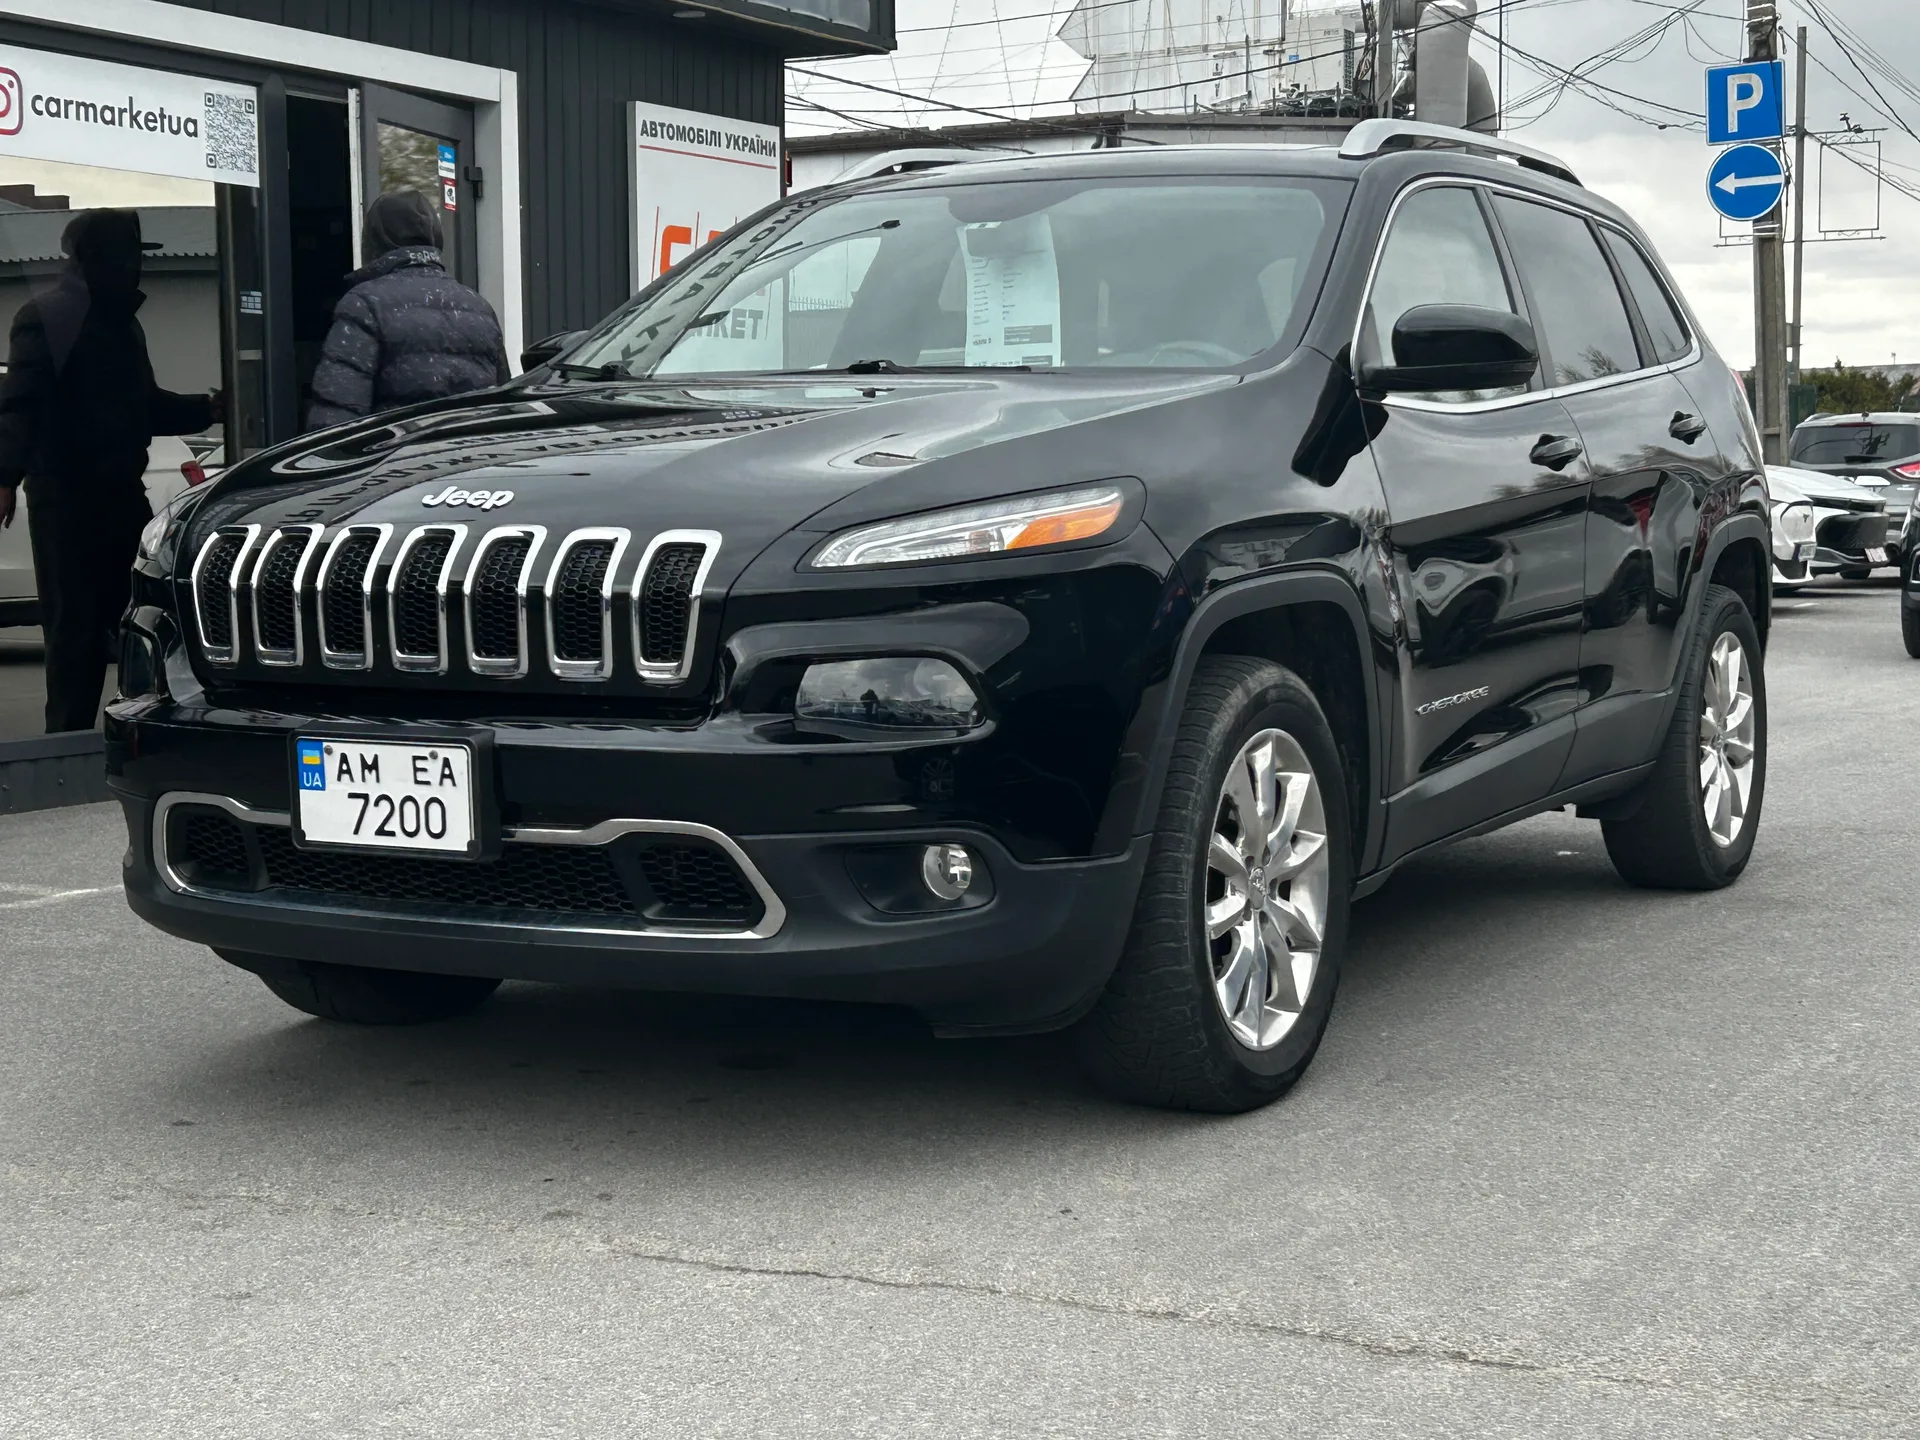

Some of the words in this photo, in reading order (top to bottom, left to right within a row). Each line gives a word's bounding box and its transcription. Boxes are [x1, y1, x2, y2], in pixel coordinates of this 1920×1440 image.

[31, 95, 199, 138] carmarketua
[1727, 73, 1764, 133] P
[640, 119, 722, 148] АВТОМОБІЛІ
[724, 133, 777, 158] УКРАЇНИ
[421, 486, 515, 512] Jeep
[1415, 685, 1490, 716] CHEROKEE
[303, 772, 322, 788] UA
[336, 752, 380, 783] AM
[411, 755, 457, 787] EA
[347, 792, 447, 840] 7200
